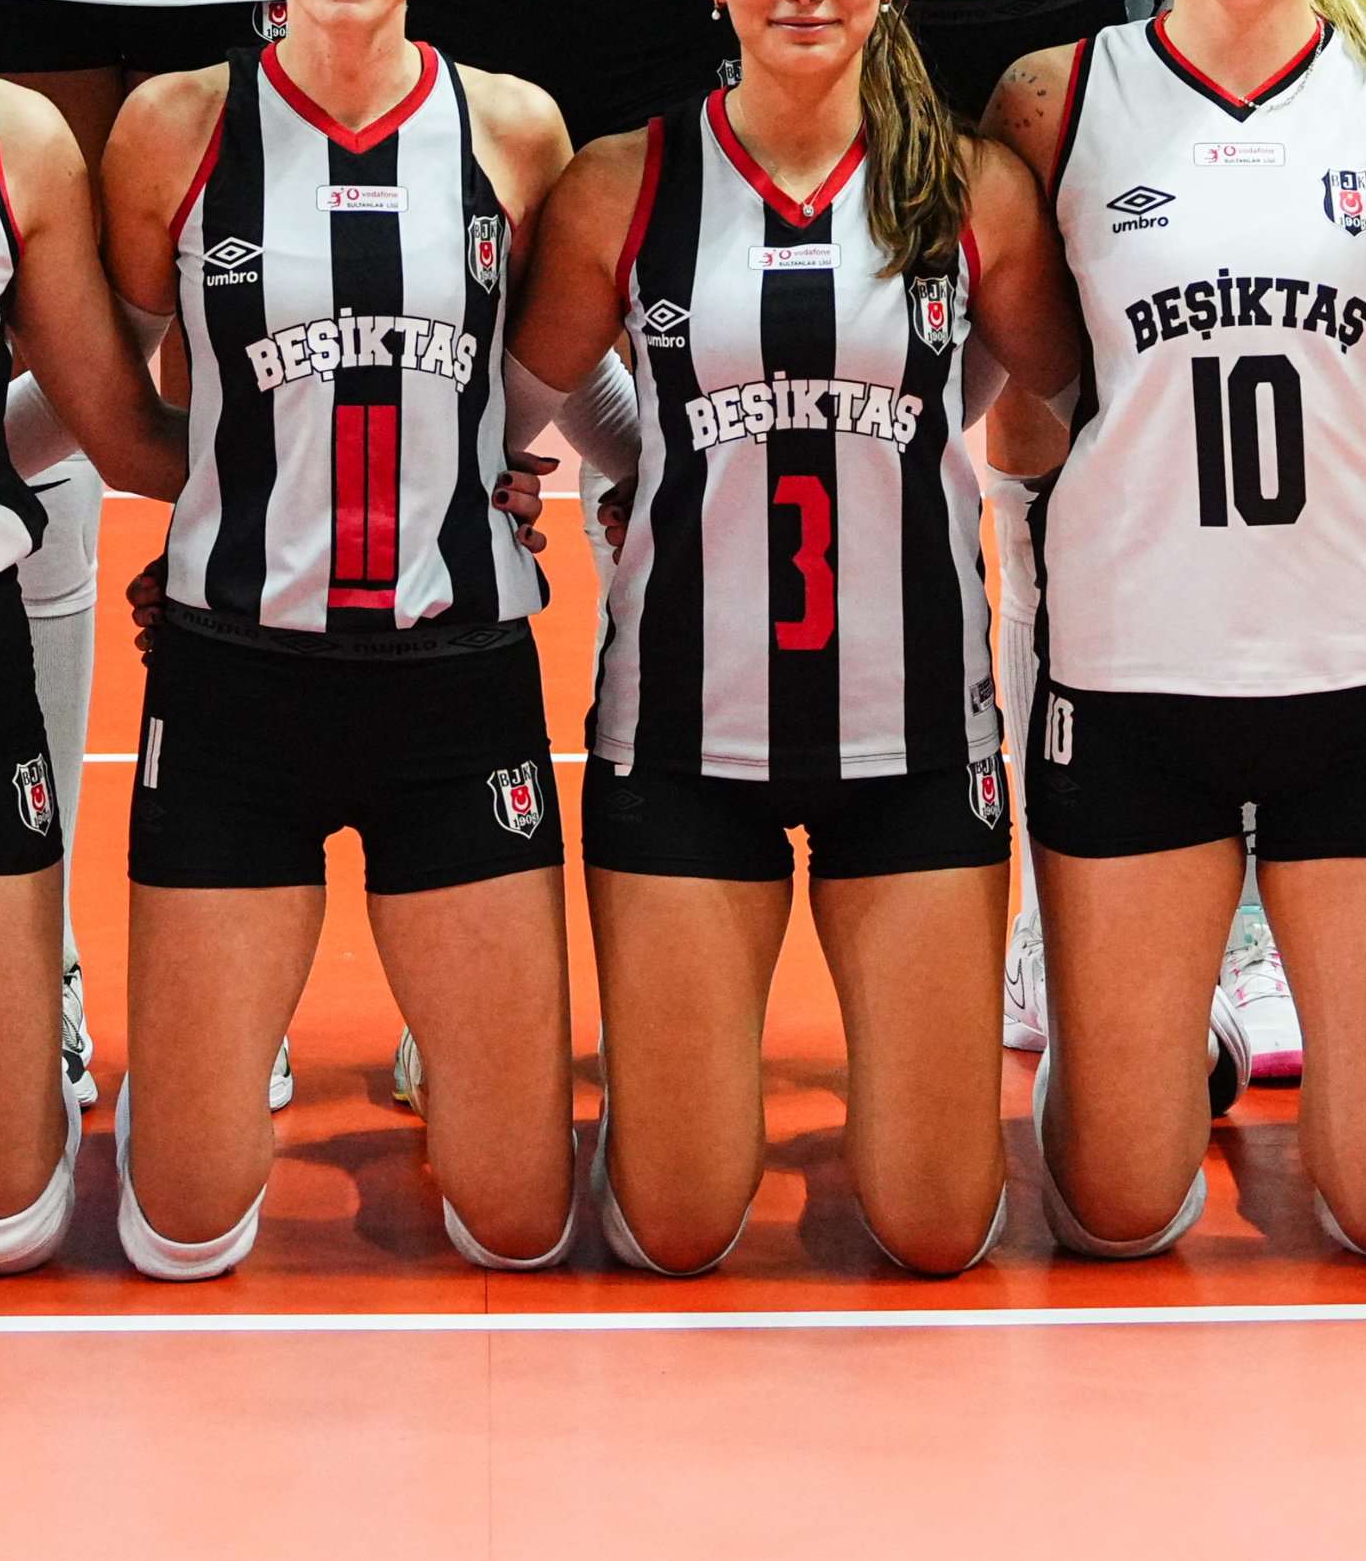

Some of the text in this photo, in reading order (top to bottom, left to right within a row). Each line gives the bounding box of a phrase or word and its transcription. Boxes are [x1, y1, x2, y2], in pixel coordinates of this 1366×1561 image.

[266, 27, 287, 38] 190
[1331, 174, 1366, 189] BJK
[362, 190, 398, 199] vodafone
[1112, 216, 1170, 234] umbro
[793, 248, 831, 256] vodafone
[207, 270, 258, 287] umbro
[919, 283, 948, 299] BJK
[245, 307, 478, 393] BEŞİKTAŞ
[685, 371, 924, 453] BEŞİKTAŞ
[1191, 353, 1308, 528] 10
[774, 474, 835, 651] 3
[1044, 690, 1075, 766] 10
[499, 765, 531, 787] BJK
